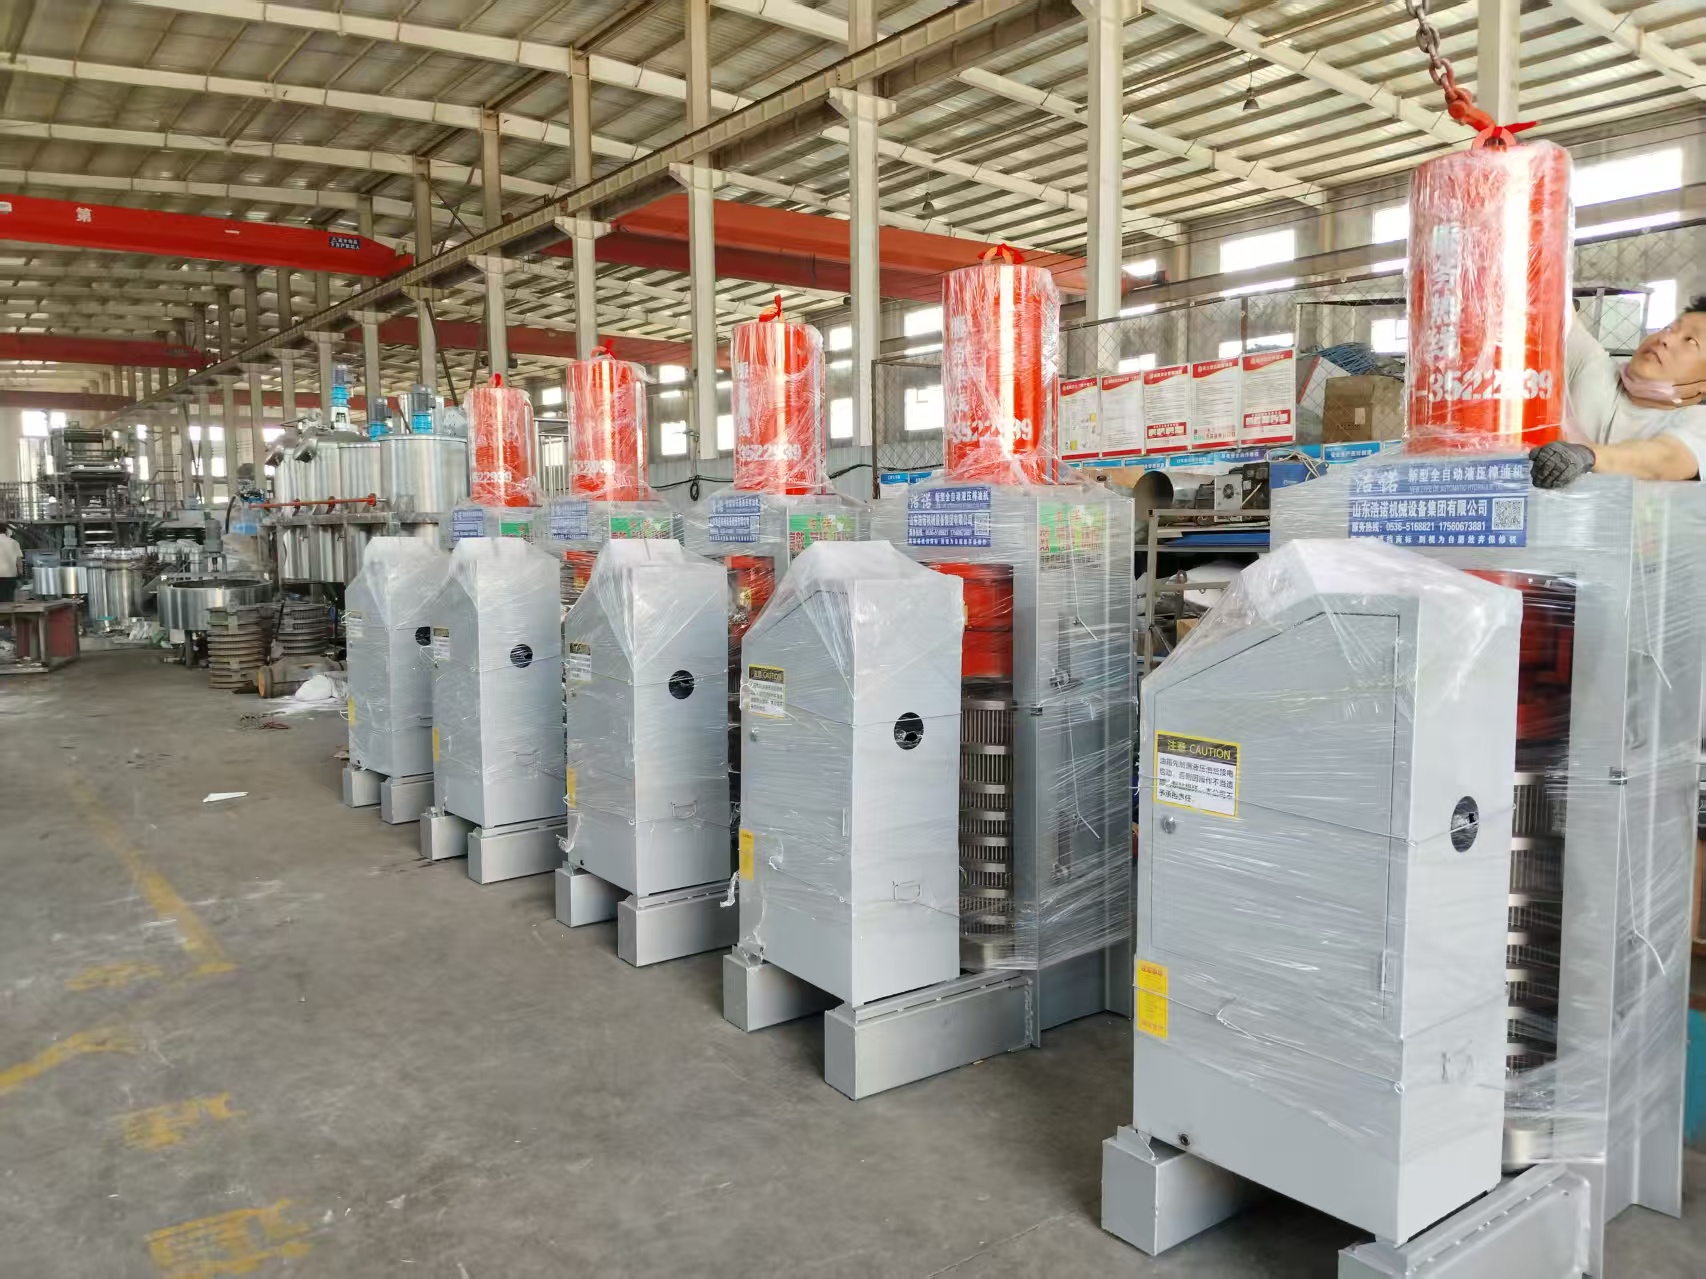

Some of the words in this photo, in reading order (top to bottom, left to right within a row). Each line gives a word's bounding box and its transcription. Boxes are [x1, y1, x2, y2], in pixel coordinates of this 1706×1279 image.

[76, 206, 92, 223] 第
[1416, 368, 1553, 402] -352239
[1408, 464, 1524, 483] 新型全自动液压榨油机
[1352, 499, 1488, 518] 山东浩诺机械设备集团有限公司
[1386, 521, 1435, 532] 0536-5168821
[1168, 740, 1187, 752] 注意
[1189, 744, 1231, 760] CAUTION
